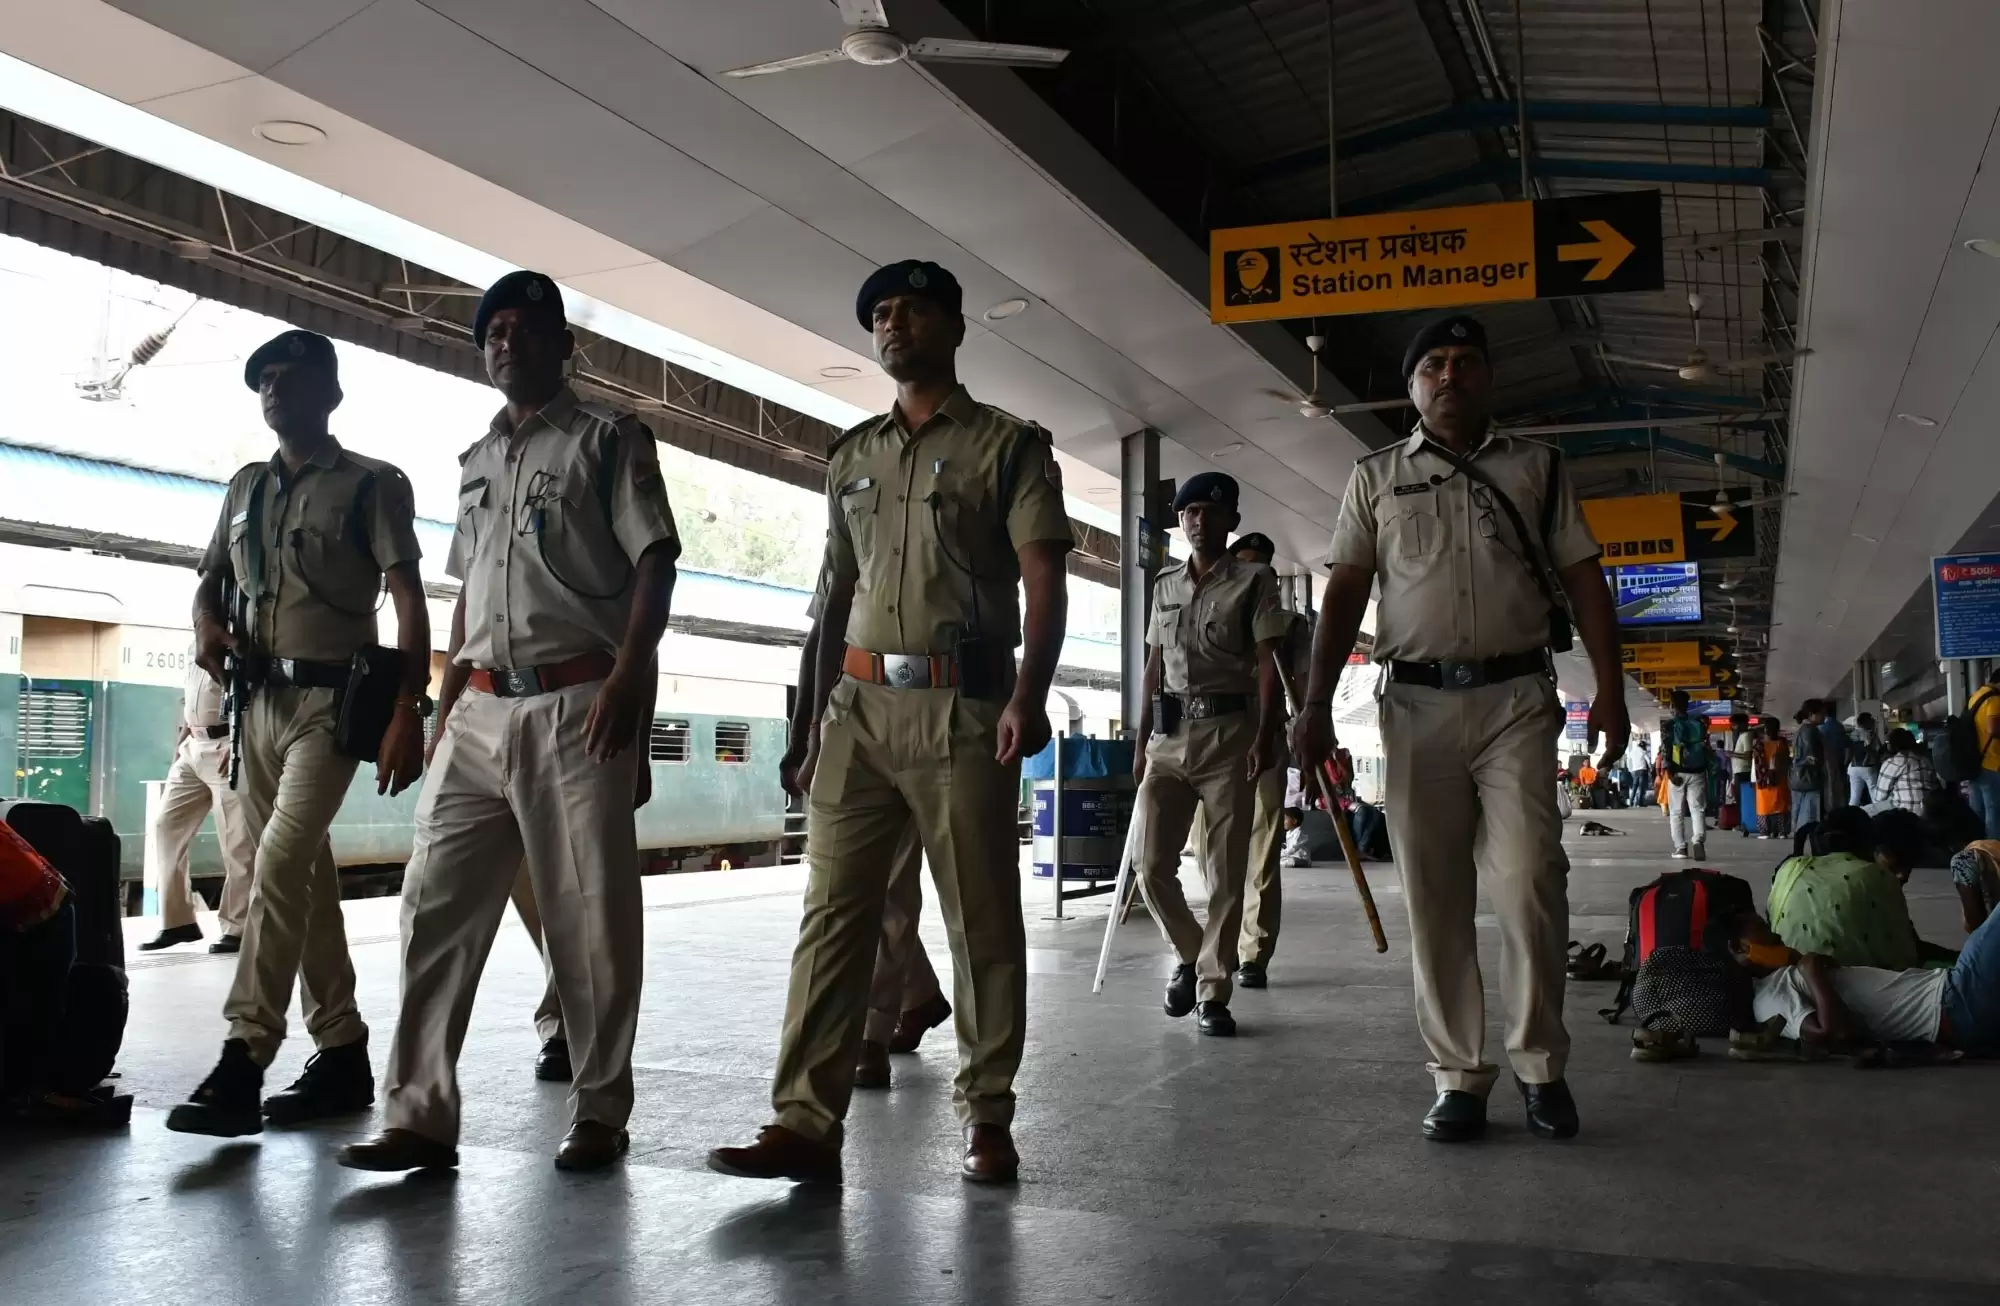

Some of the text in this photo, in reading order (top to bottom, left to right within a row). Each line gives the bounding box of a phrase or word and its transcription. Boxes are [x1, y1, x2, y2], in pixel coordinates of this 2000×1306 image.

[1289, 225, 1467, 267] स्टेशन प्रबंधक
[1292, 261, 1530, 297] Station Manager
